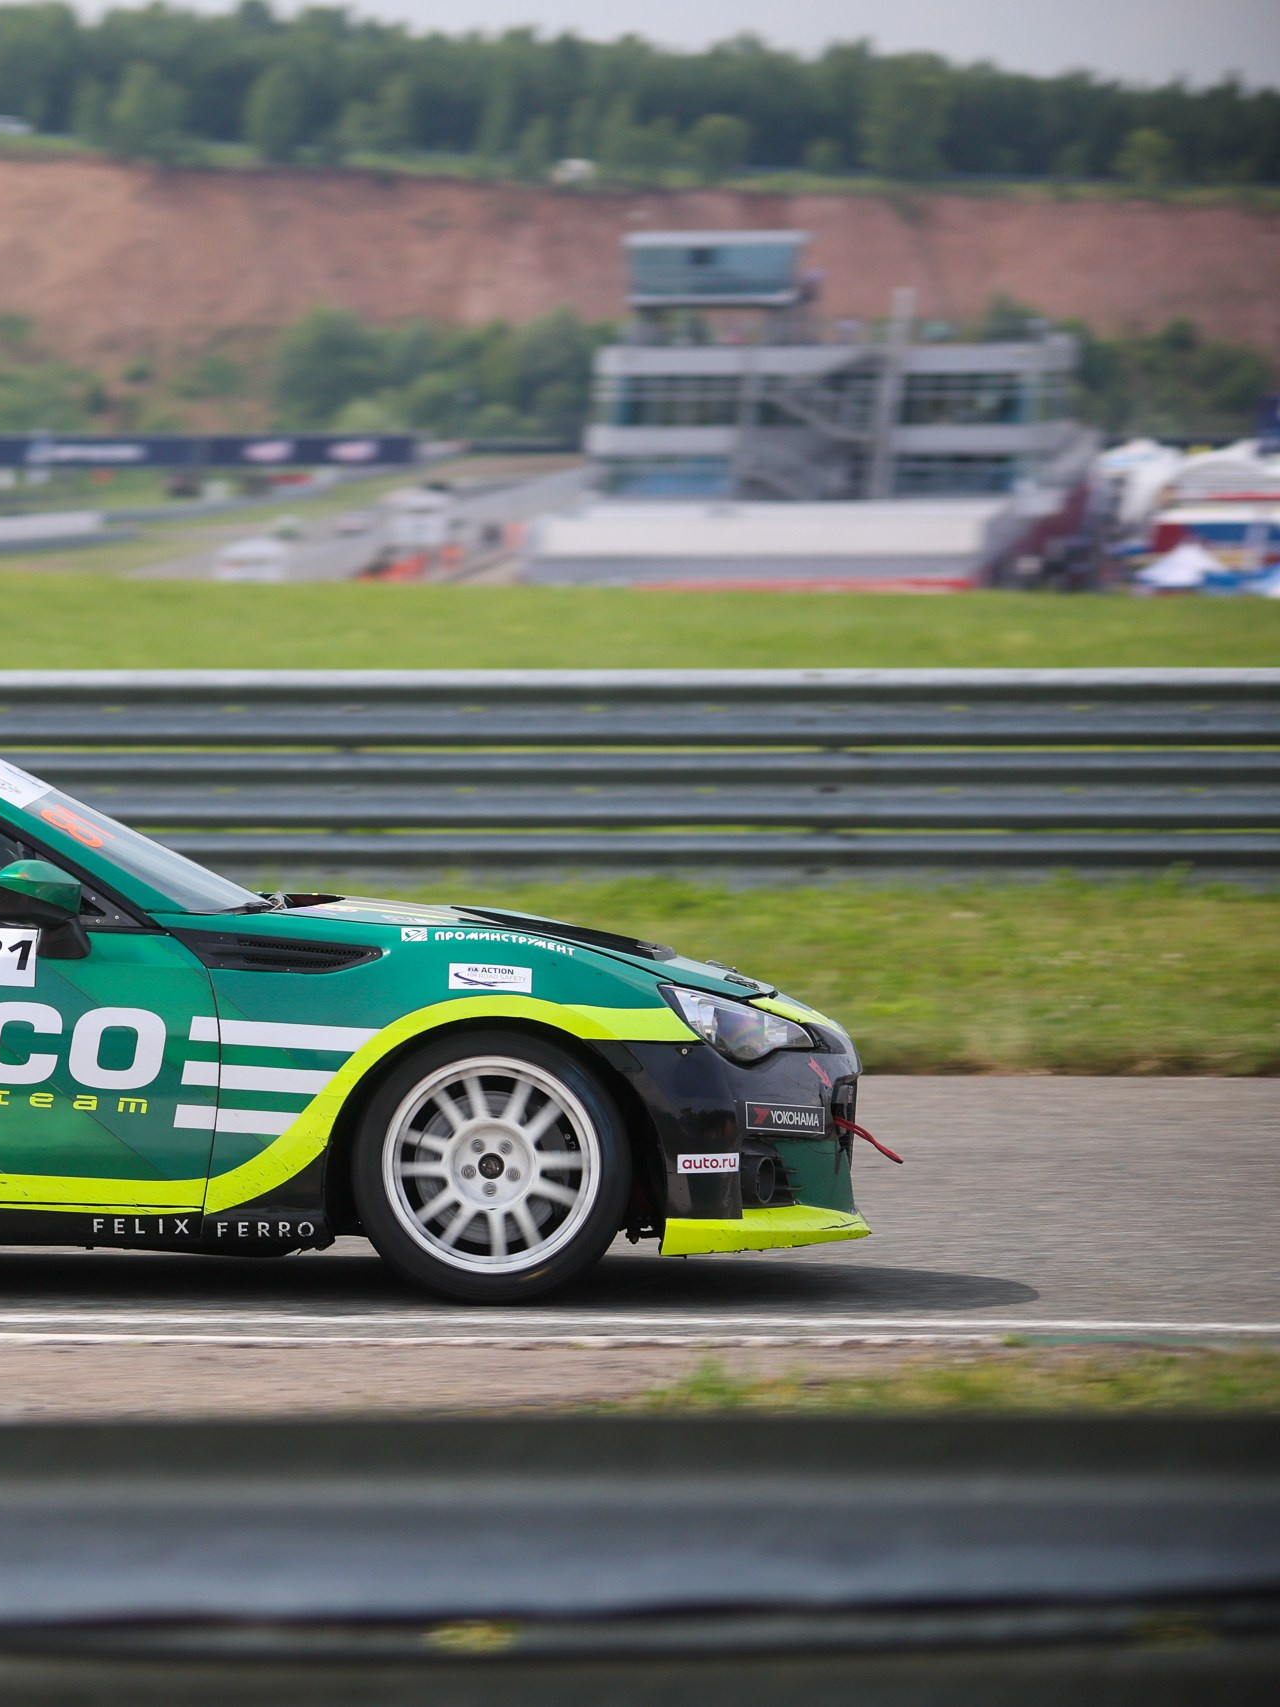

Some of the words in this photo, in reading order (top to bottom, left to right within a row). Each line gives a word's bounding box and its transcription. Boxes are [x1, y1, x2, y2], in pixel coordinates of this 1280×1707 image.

[434, 931, 576, 956] ПРОМИНСТРУМЕНТ
[481, 967, 515, 975] ACTION
[500, 974, 527, 982] SAFETY
[770, 1109, 820, 1127] YOKOHAMA
[682, 1156, 737, 1169] auto.ru
[92, 1218, 190, 1235] FELIX
[216, 1221, 315, 1238] FERRO
